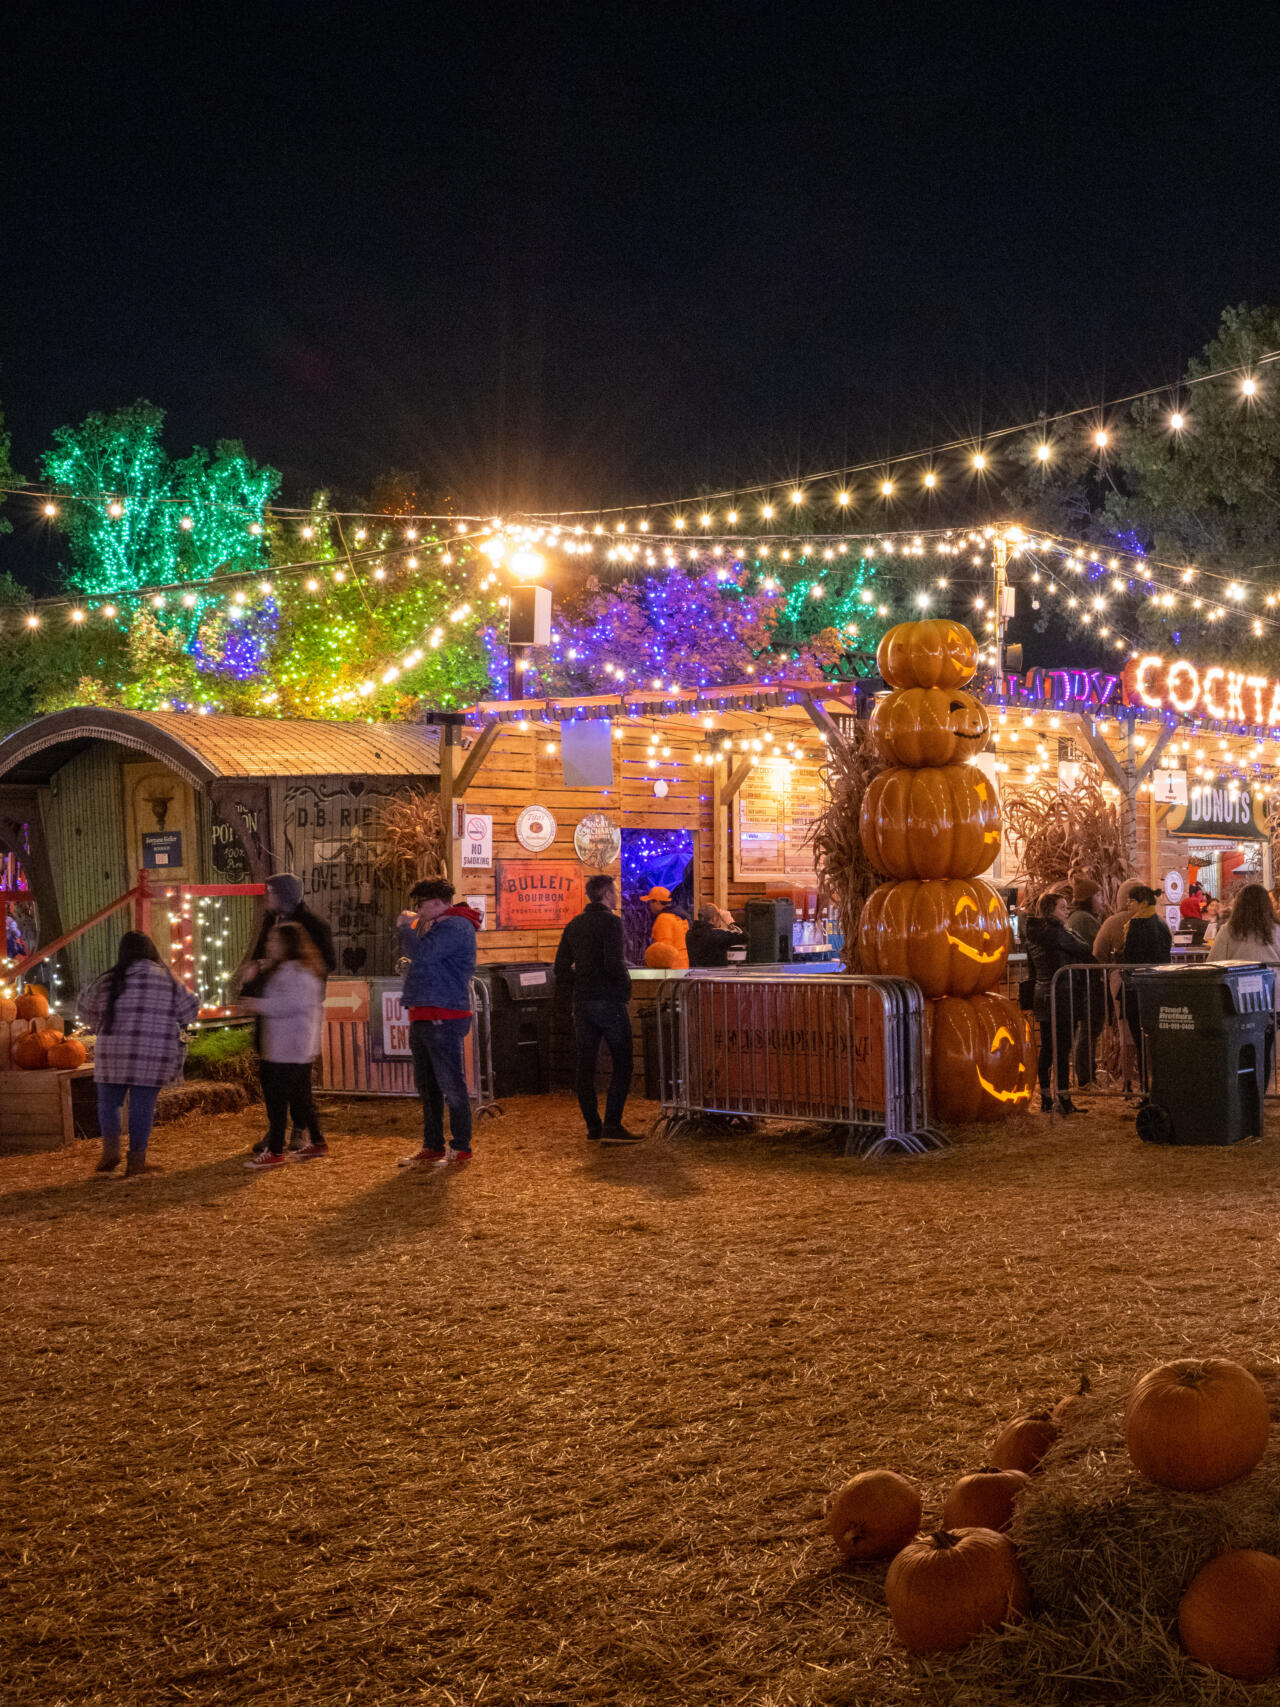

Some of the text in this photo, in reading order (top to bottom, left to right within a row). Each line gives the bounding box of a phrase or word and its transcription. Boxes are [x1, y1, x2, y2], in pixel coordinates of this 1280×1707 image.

[1191, 786, 1250, 824] DONUTS
[297, 808, 332, 828] D.B.
[471, 844, 482, 855] NO
[463, 856, 490, 866] SMOKING
[302, 865, 340, 894] LOVE
[507, 875, 574, 893] BULLEIT
[518, 893, 564, 902] BOURBON
[385, 997, 402, 1022] DO
